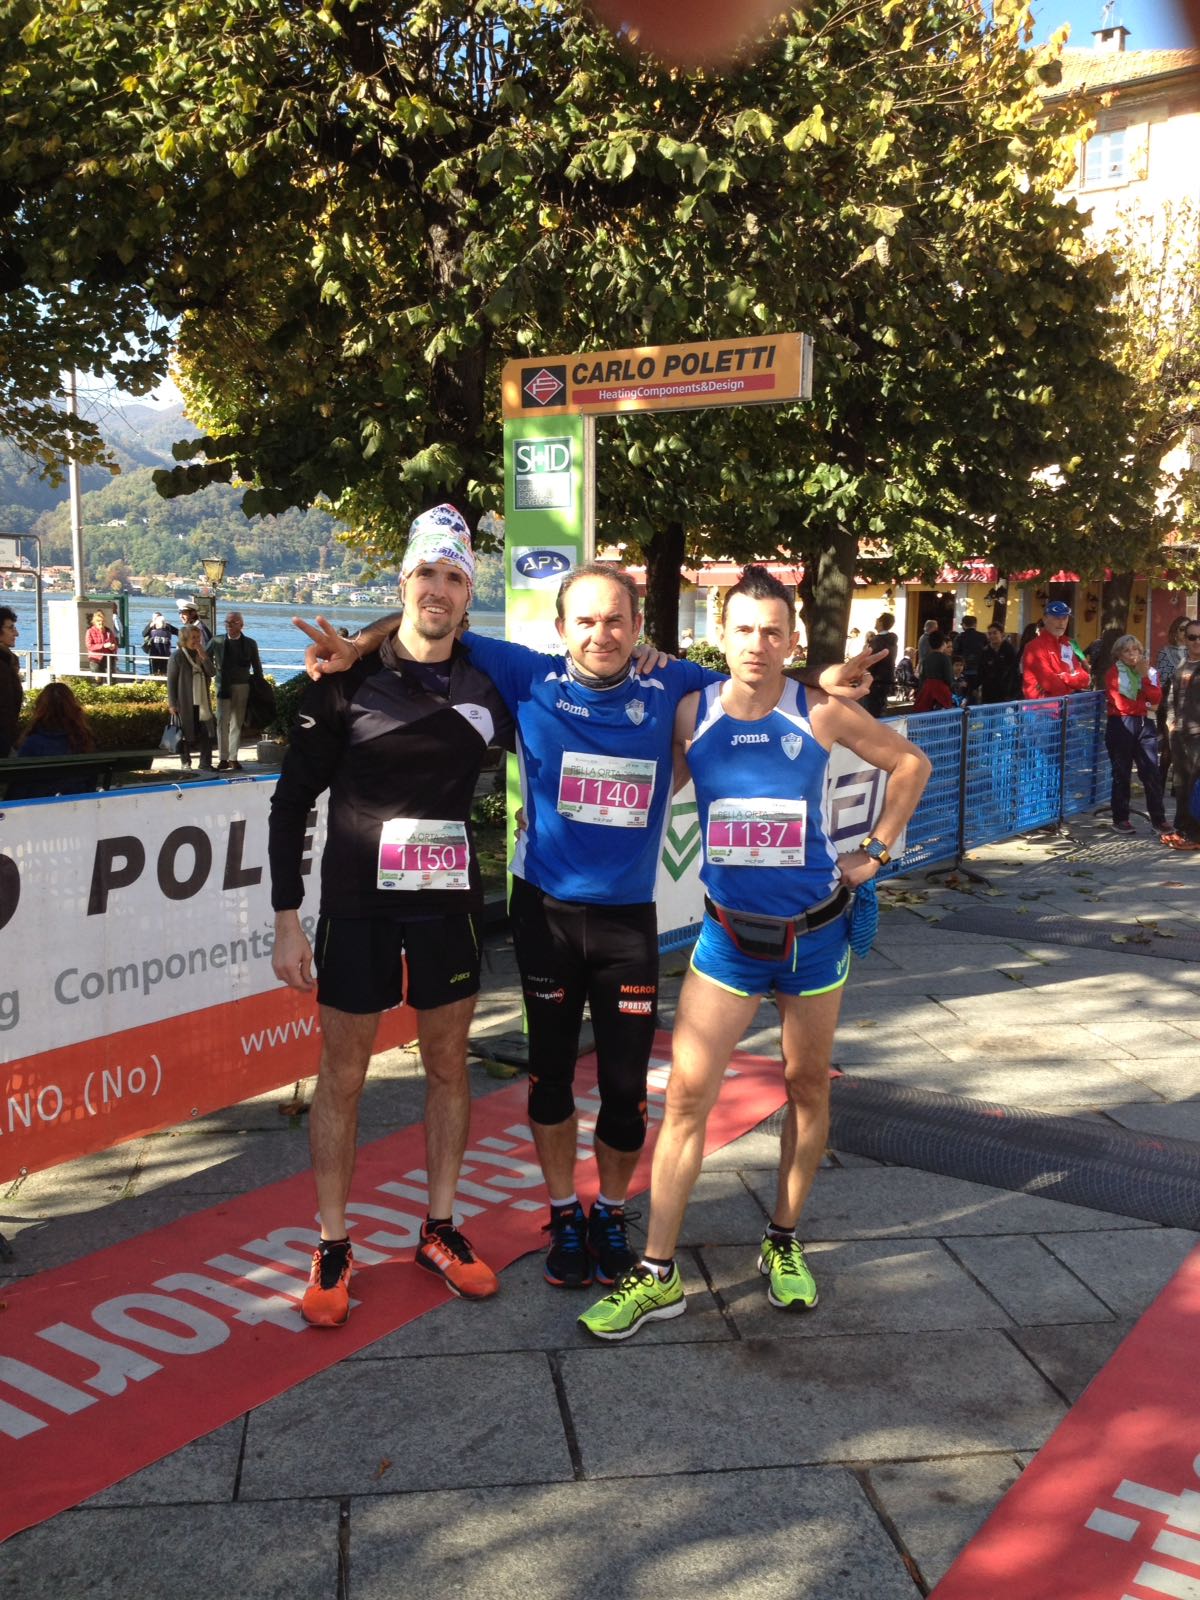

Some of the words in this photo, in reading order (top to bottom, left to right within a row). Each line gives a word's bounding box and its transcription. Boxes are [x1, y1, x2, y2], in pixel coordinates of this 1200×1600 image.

[572, 357, 655, 385] CARLO
[663, 345, 776, 378] POLETTI
[599, 379, 744, 400] HeatingComponents&Design
[517, 443, 570, 473] SHD
[523, 556, 564, 572] APS
[577, 779, 639, 808] 1140
[724, 822, 788, 847] 1137
[397, 846, 456, 870] 1150
[54, 929, 274, 1005] Components
[620, 984, 656, 995] MIGROS
[0, 1085, 63, 1135] NO
[84, 1054, 162, 1116] (No)
